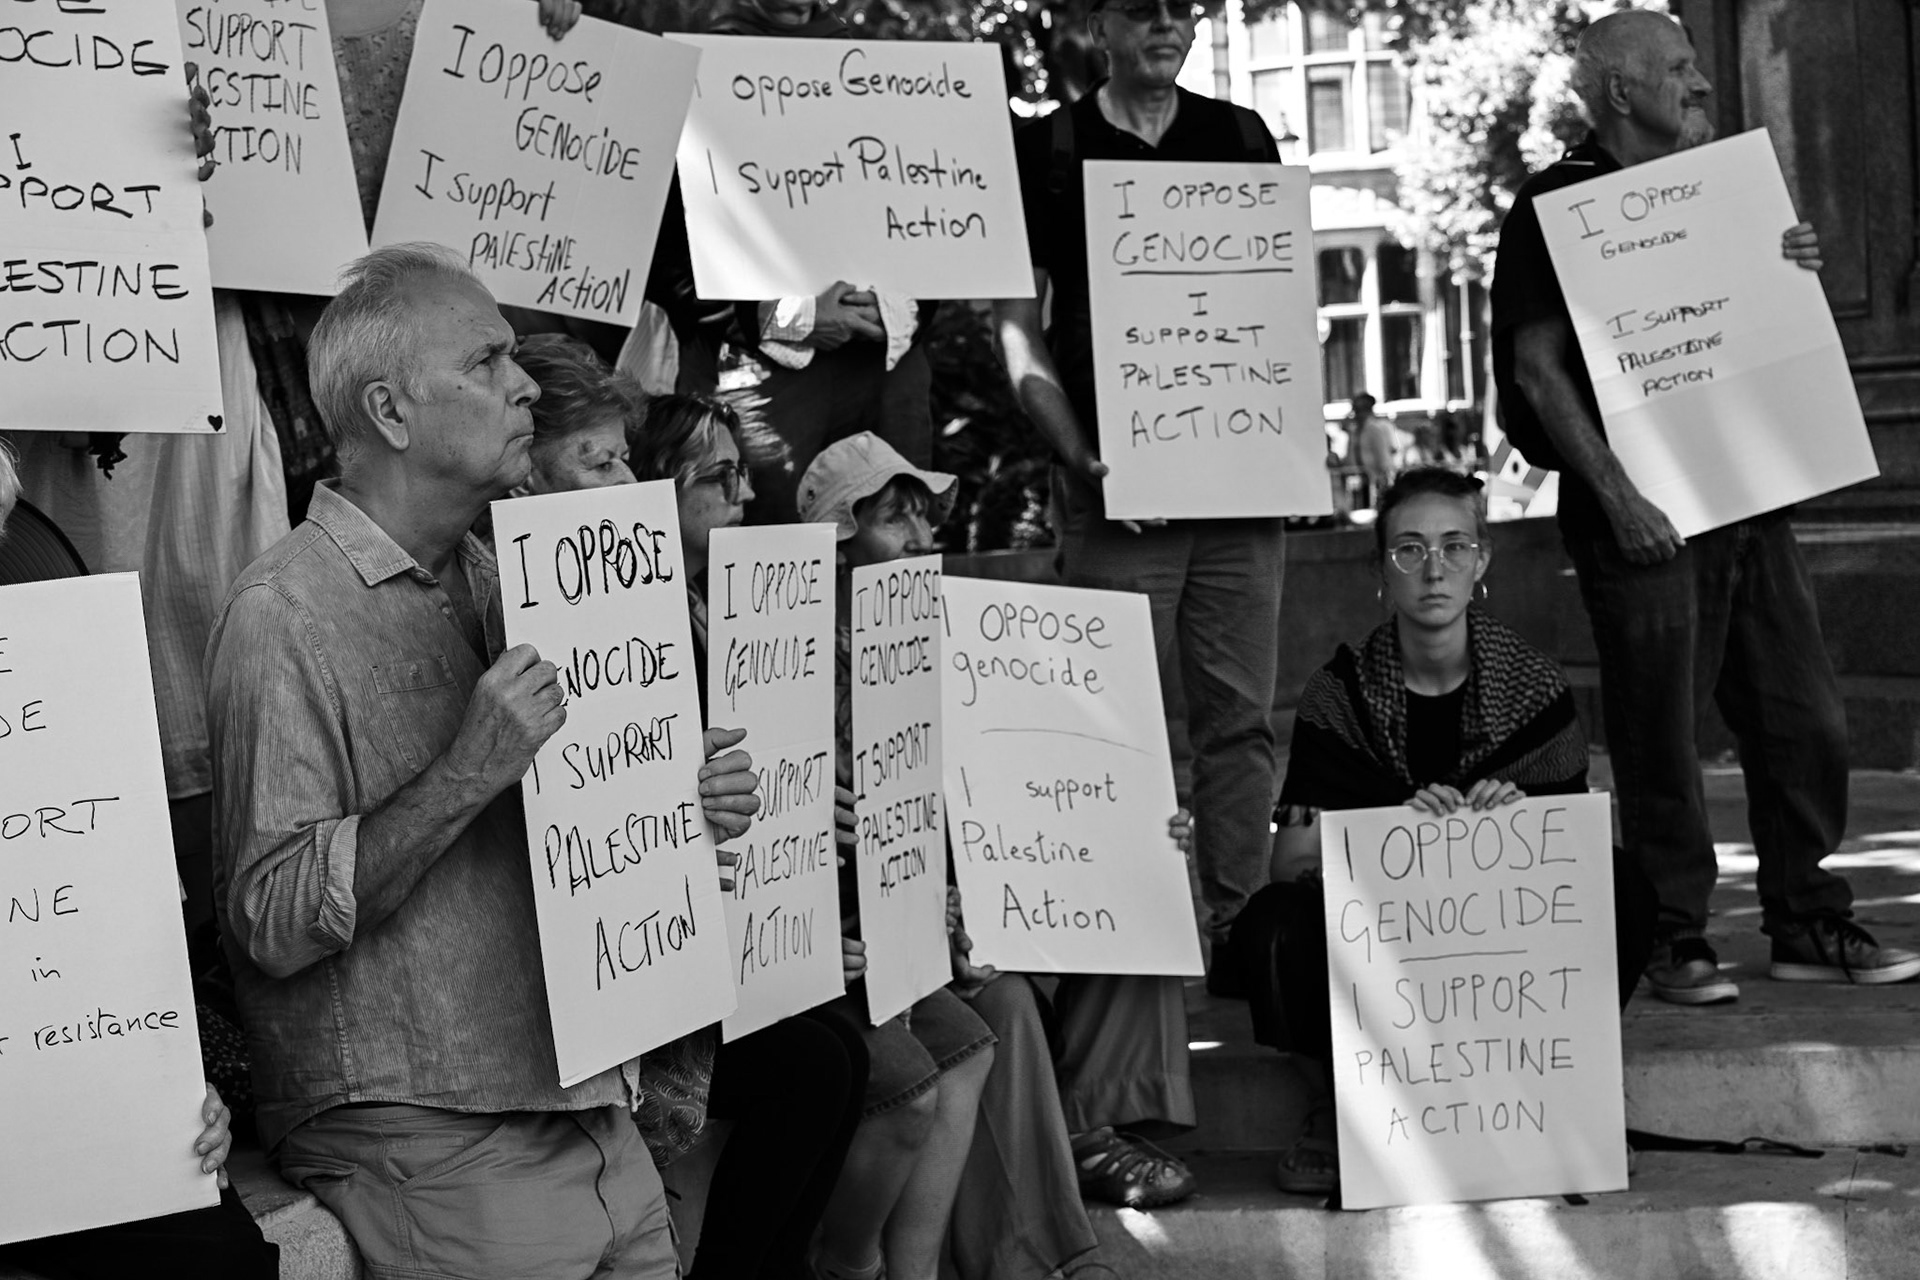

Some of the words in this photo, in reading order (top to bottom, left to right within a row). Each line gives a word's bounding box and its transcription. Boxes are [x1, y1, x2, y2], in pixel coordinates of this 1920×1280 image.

[186, 6, 318, 71] SUPPORT
[443, 24, 475, 78] I
[207, 67, 320, 120] ESTINE
[838, 47, 973, 100] Genocide
[8, 132, 33, 171] I
[414, 148, 446, 201] I
[707, 148, 718, 195] I
[737, 150, 846, 210] Support
[847, 135, 988, 191] Palestine
[885, 204, 987, 241] Action
[1112, 179, 1136, 220] I
[1162, 181, 1280, 210] OPPOSE
[1567, 198, 1605, 240] I
[1112, 230, 1294, 266] GENOCIDE
[1600, 229, 1687, 260] GENOCIDE
[1187, 291, 1209, 317] I
[1605, 309, 1638, 340] I
[1642, 297, 1730, 332] SUPPORT
[1124, 324, 1266, 348] SUPPORT
[1617, 331, 1722, 374] PALESTINE
[1119, 359, 1293, 391] PALESTINE
[1642, 367, 1713, 397] ACTION
[1130, 405, 1283, 448] ACTION
[511, 532, 540, 610] I
[554, 518, 674, 607] OPPOSE
[723, 562, 738, 621] I
[751, 558, 822, 616] OPPOSE
[855, 586, 869, 634] I
[873, 568, 941, 628] OPPOSE
[942, 595, 950, 638] I
[556, 637, 679, 707] NOCIDE
[724, 634, 816, 713] GENOCIDE
[859, 634, 933, 687] GENOCIDE
[952, 647, 1105, 708] genocide
[757, 751, 827, 821] SUPPORT
[856, 750, 867, 800] I
[872, 722, 931, 787] SUPPORT
[961, 766, 971, 807] I
[1025, 772, 1118, 813] support
[545, 801, 702, 897] PALESTINE
[862, 792, 937, 856] PALESTINE
[961, 819, 1094, 865] Palestine
[1343, 825, 1355, 883] I
[1381, 808, 1577, 880] OPPOSE
[734, 831, 828, 900] PALESTINE
[880, 845, 926, 897] ACTION
[596, 874, 696, 990] ACTION
[1002, 882, 1116, 933] Action
[1340, 884, 1583, 964] GENOCIDE
[30, 956, 61, 983] in
[740, 905, 814, 986] ACTION
[1351, 981, 1363, 1032] I
[1392, 966, 1582, 1030] SUPPORT
[33, 1006, 180, 1051] resistance
[1356, 1038, 1574, 1085] PALESTINE
[1387, 1099, 1545, 1145] ACTION
